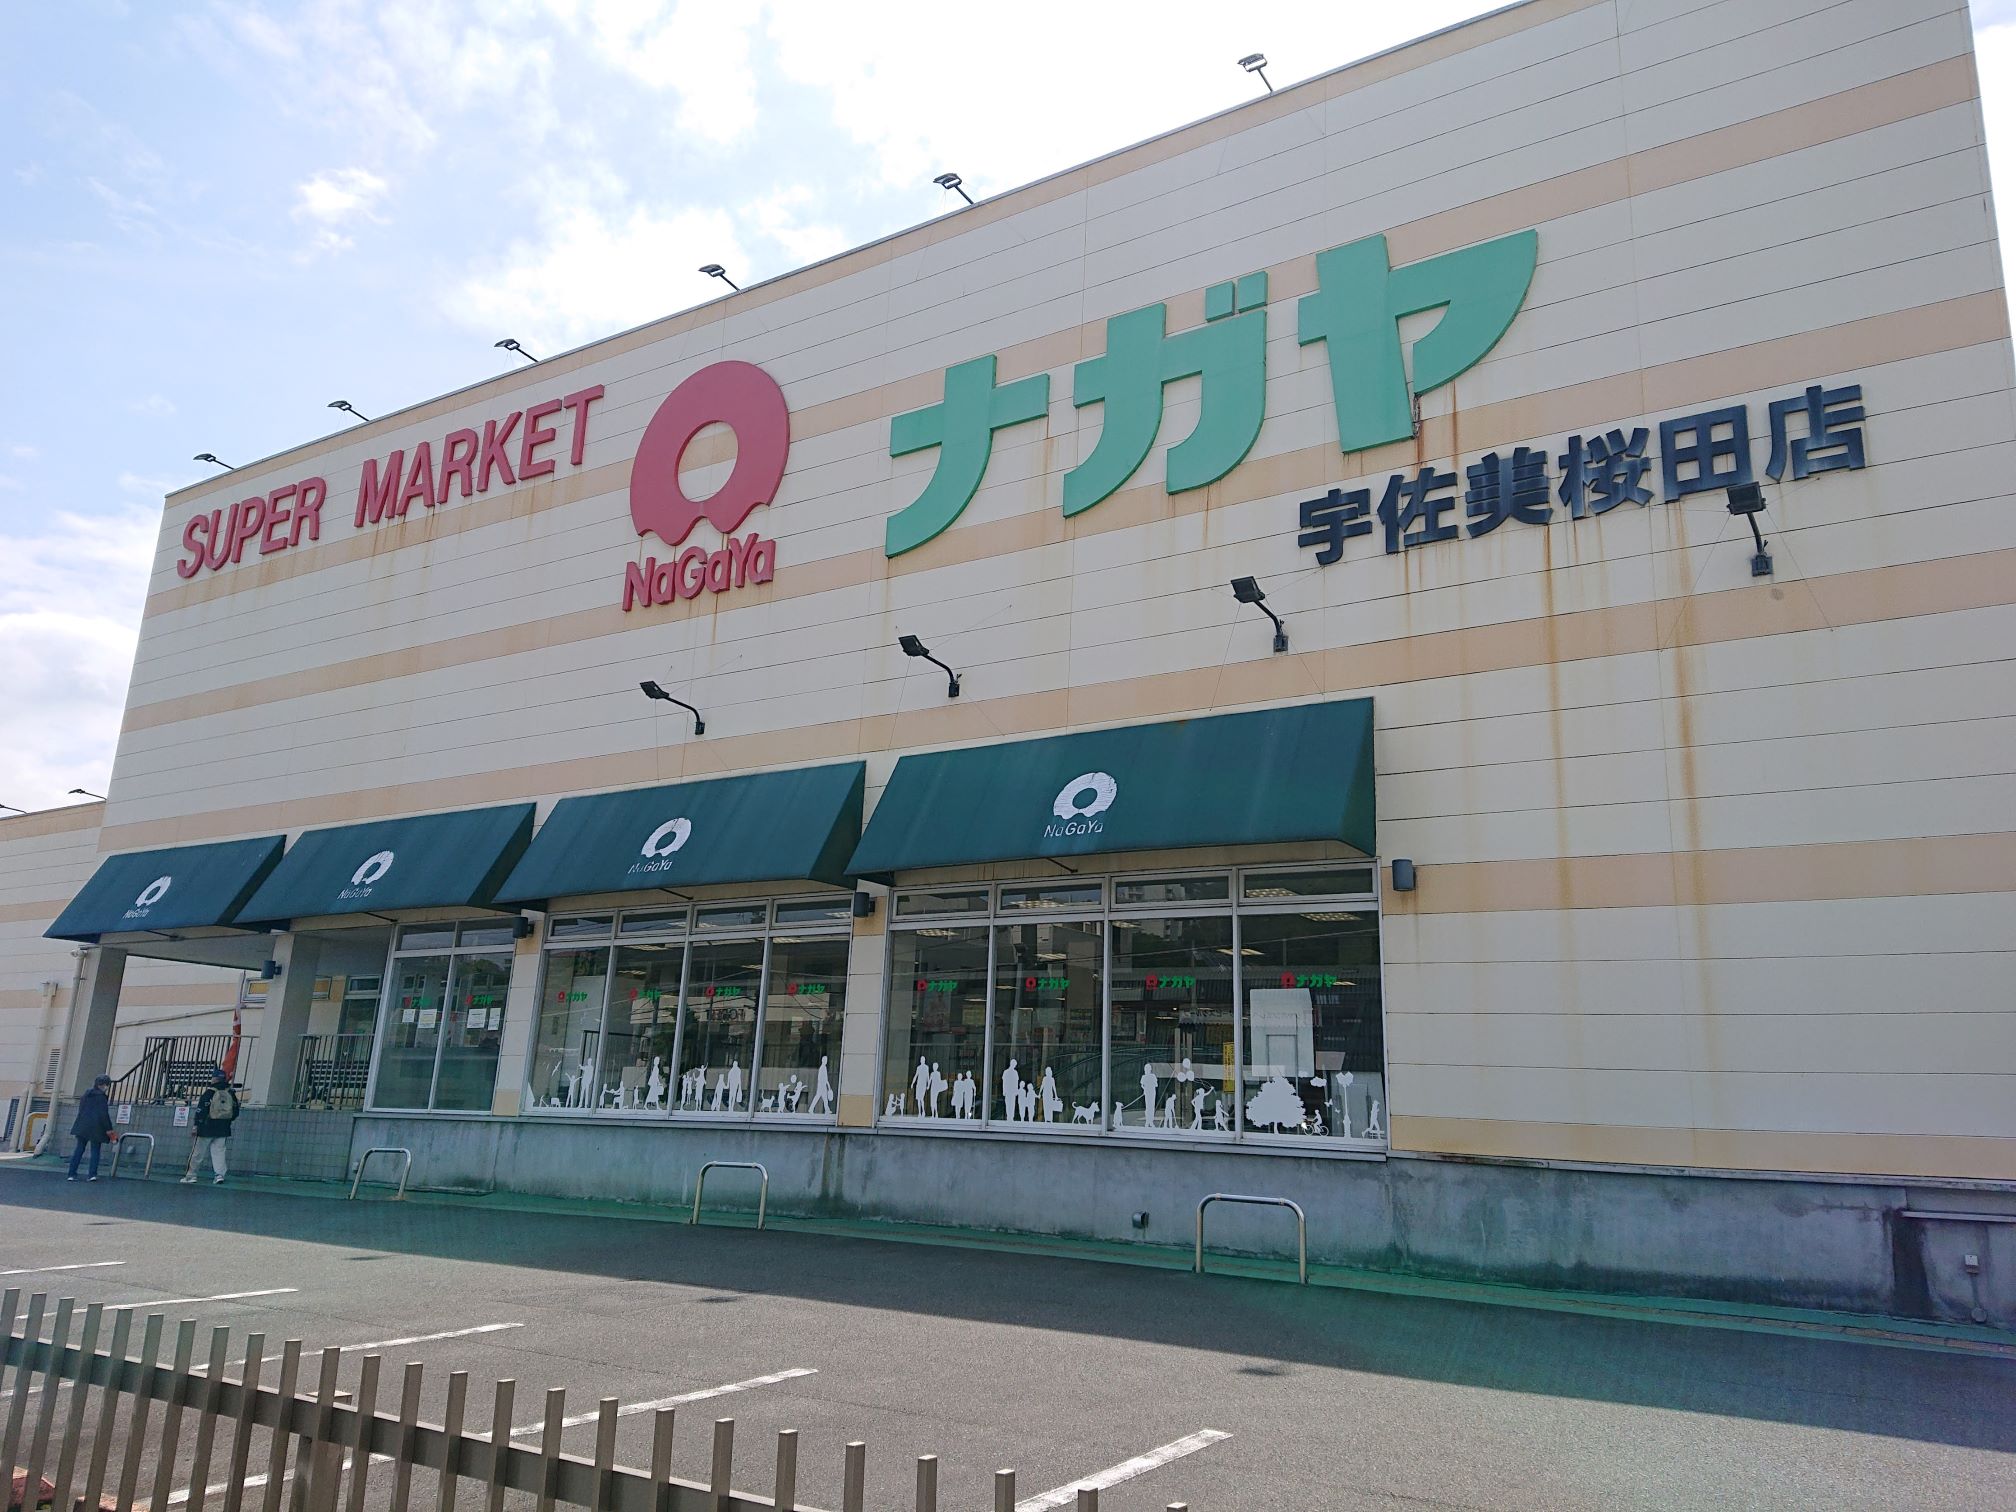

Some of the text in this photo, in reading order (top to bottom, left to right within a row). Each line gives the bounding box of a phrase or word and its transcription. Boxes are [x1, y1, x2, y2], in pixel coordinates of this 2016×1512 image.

[177, 384, 604, 579] SUPER MARKET
[885, 228, 1538, 559] ナガヤ
[1297, 383, 1867, 567] 宇佐美桜田店
[621, 532, 776, 612] NaGaYa
[1043, 819, 1104, 838] NaGaYa
